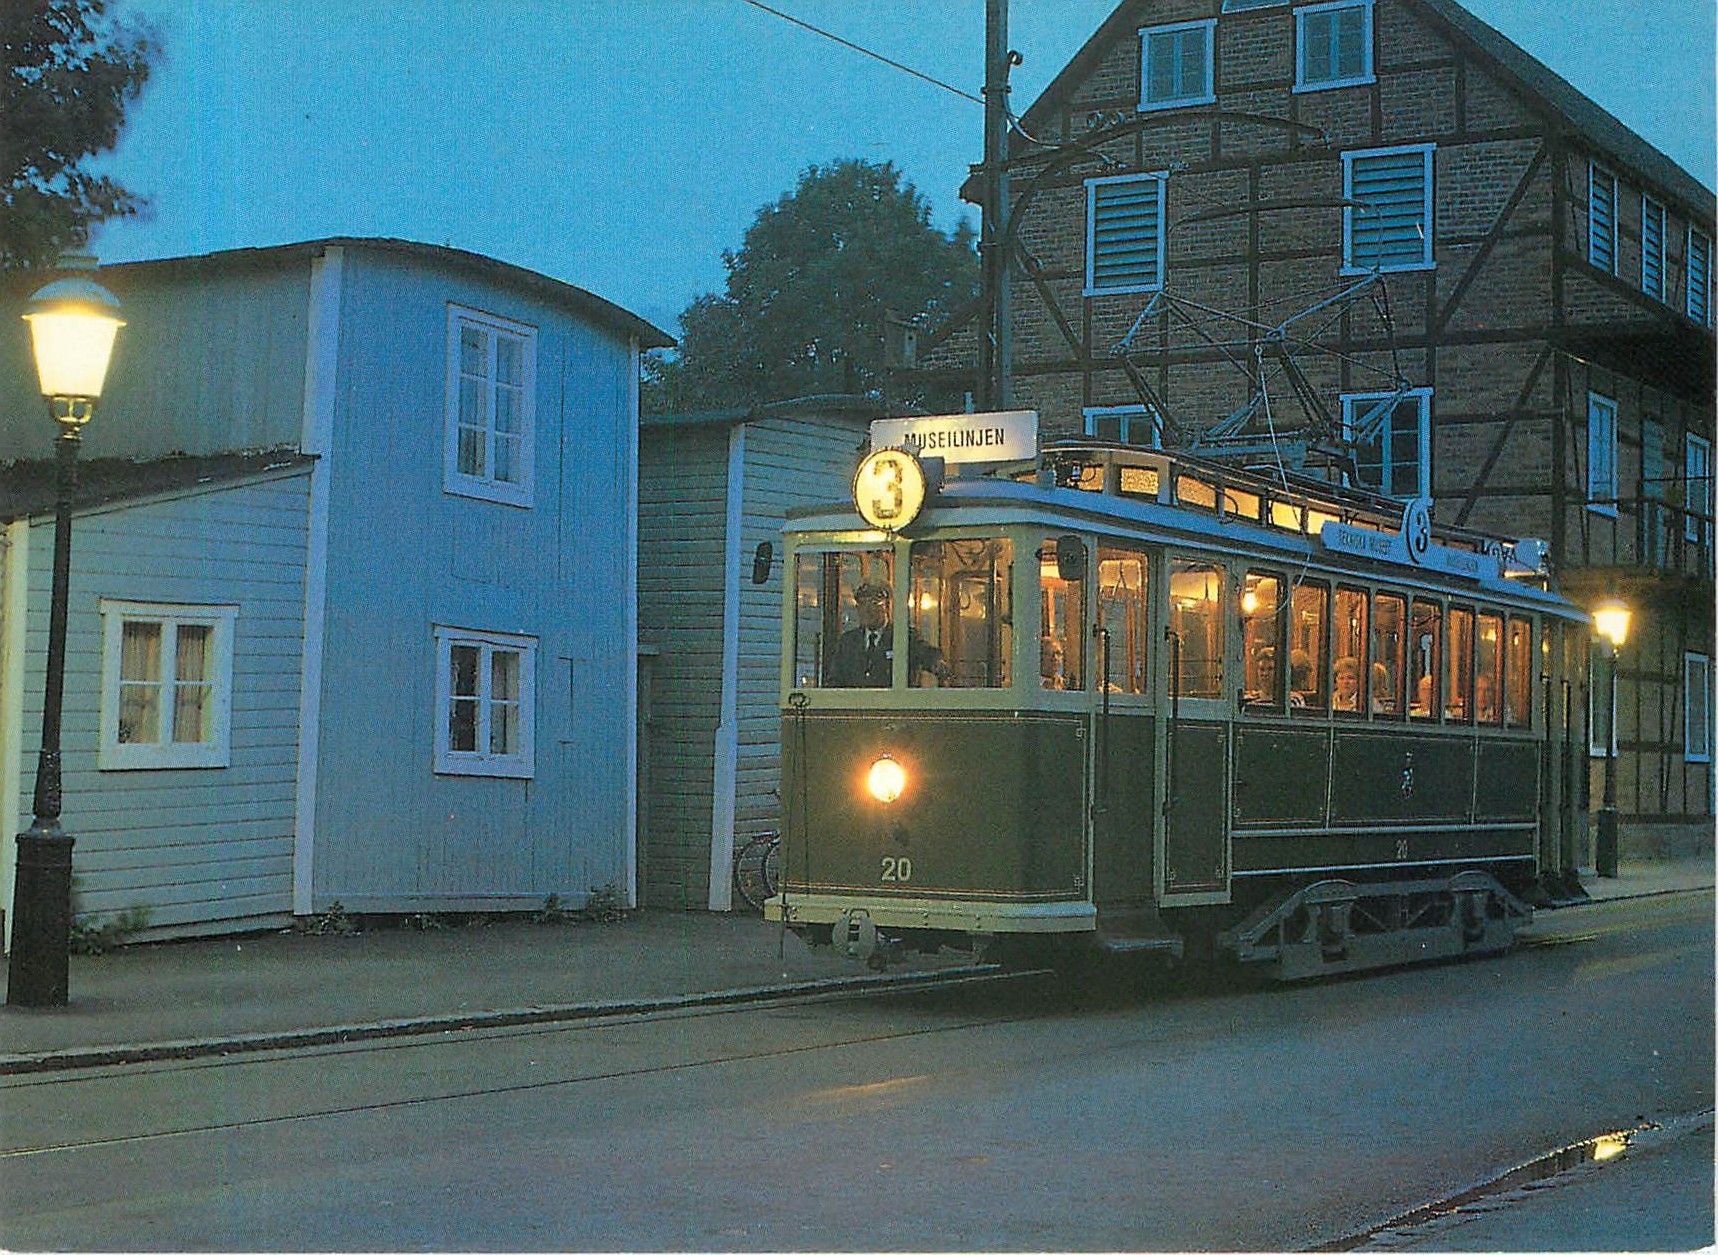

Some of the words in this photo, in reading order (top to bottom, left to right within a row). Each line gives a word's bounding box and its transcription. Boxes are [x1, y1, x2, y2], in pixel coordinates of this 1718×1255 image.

[904, 428, 1005, 450] MUSEILINJEN
[872, 459, 903, 519] 3
[1415, 511, 1428, 554] 3
[881, 857, 912, 881] 20
